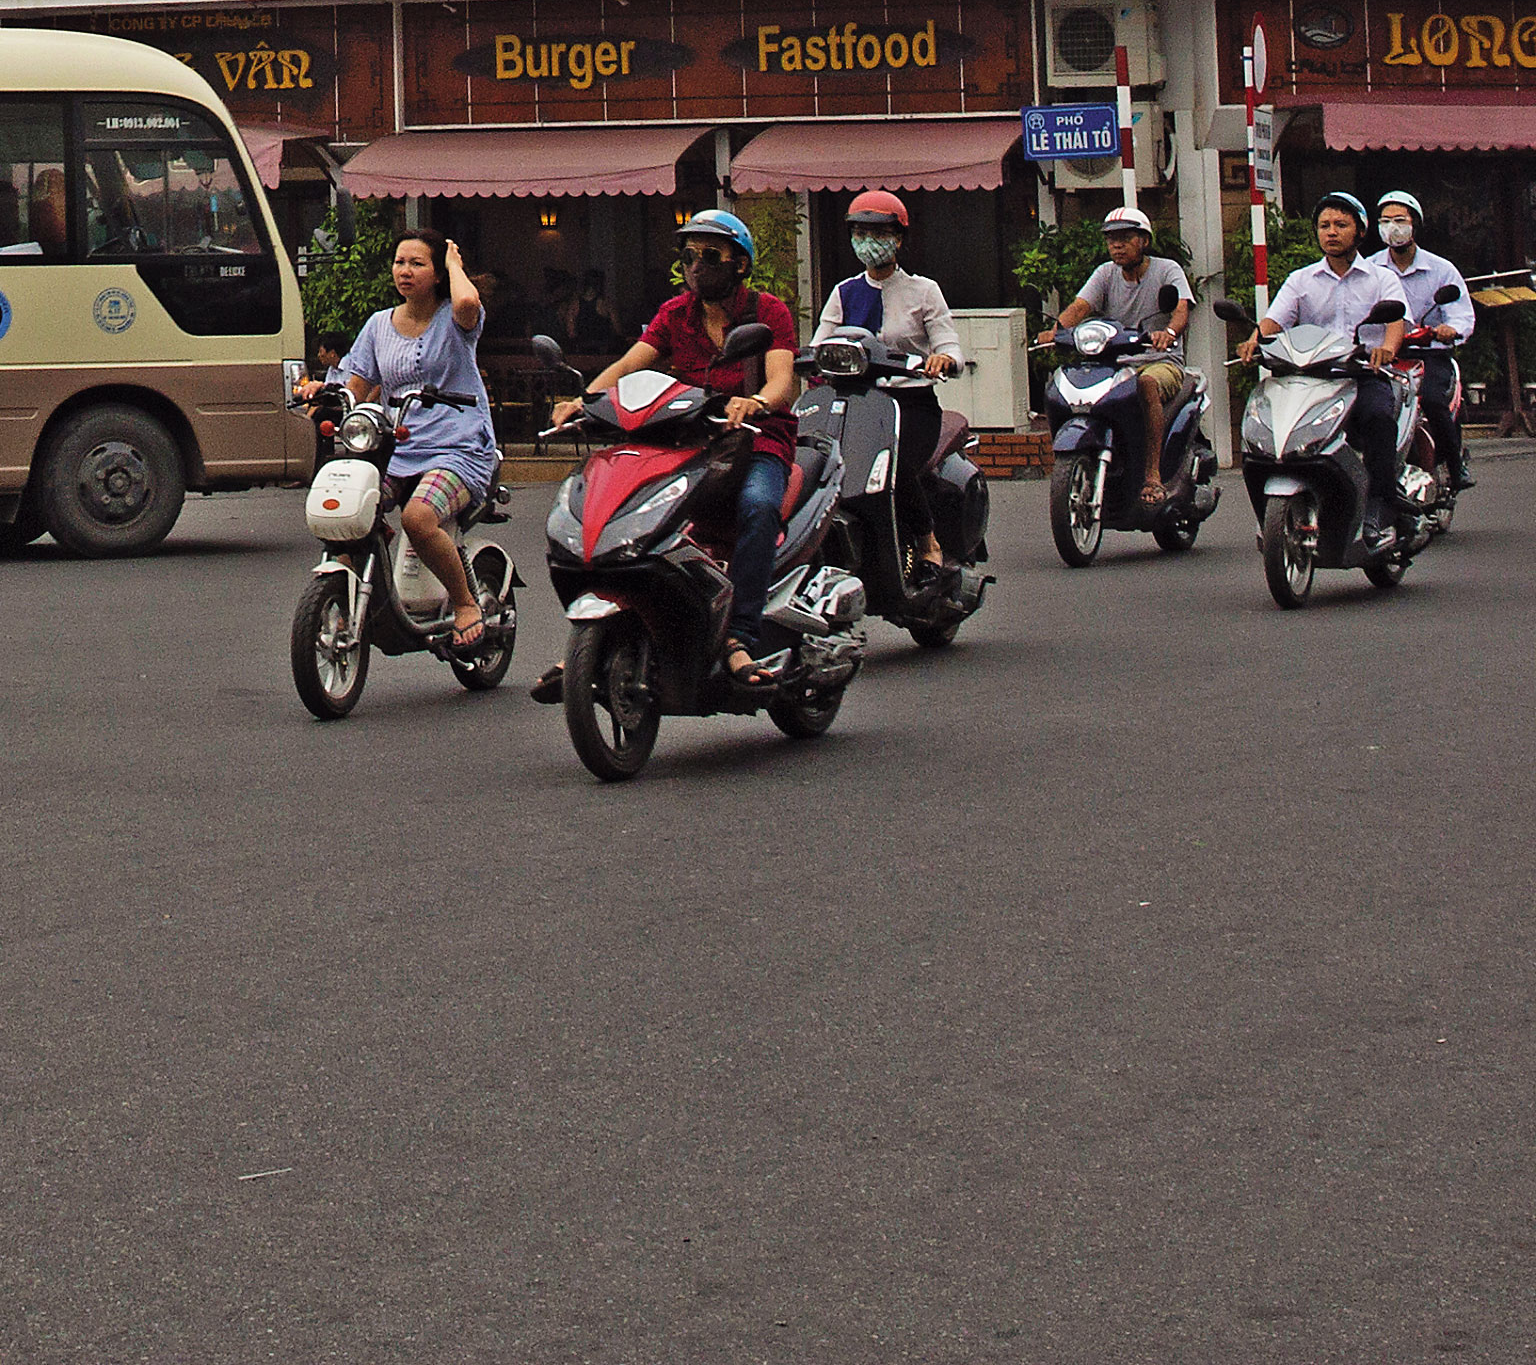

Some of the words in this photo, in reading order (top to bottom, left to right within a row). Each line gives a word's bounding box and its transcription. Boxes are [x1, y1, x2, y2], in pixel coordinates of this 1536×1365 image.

[494, 33, 637, 90] Burger
[756, 19, 937, 72] Fastfood
[213, 41, 314, 92] VÂN
[1055, 111, 1085, 127] PHỐ
[1031, 129, 1051, 153] LÊ
[1053, 126, 1089, 152] THÁI
[219, 265, 247, 277] DELUXE
